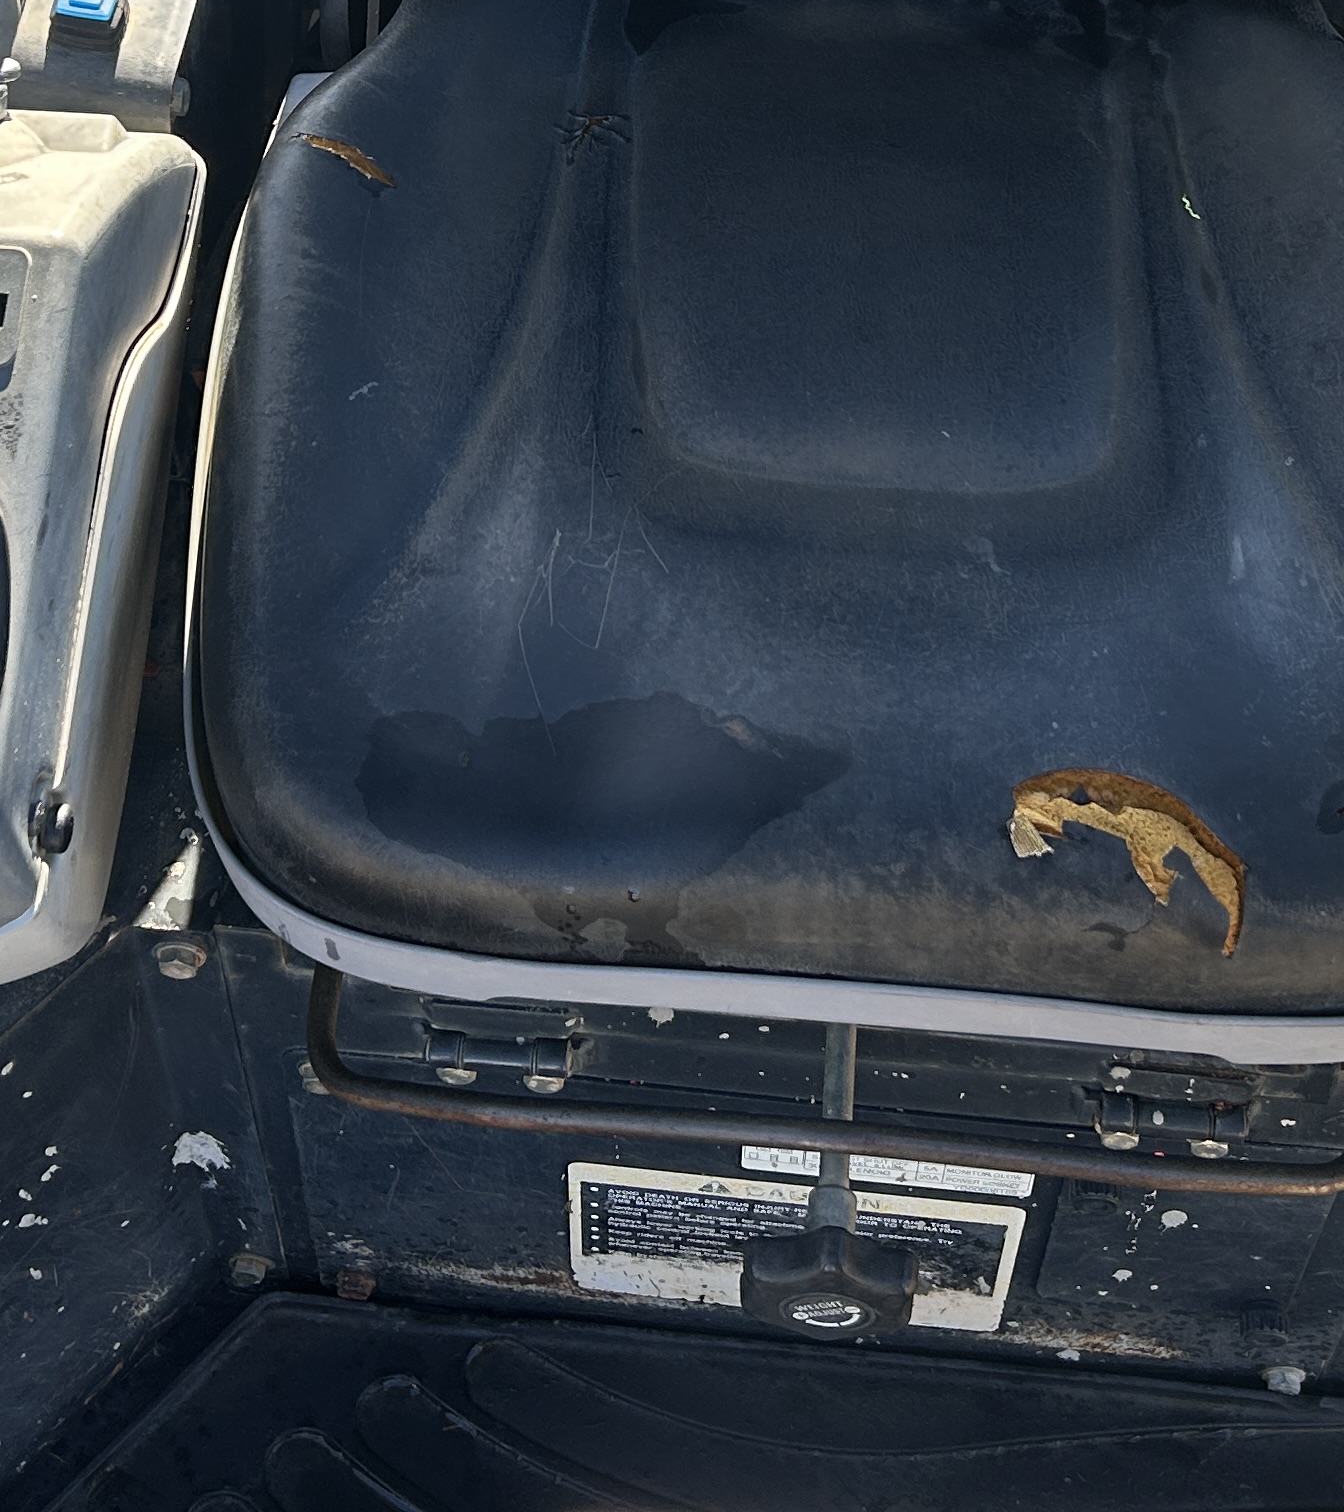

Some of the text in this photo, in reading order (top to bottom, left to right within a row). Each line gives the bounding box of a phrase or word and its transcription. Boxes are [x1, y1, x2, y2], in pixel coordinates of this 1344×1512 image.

[945, 1176, 980, 1185] POWER
[793, 1299, 843, 1311] WEIGHT
[807, 1307, 845, 1317] ADJUST
